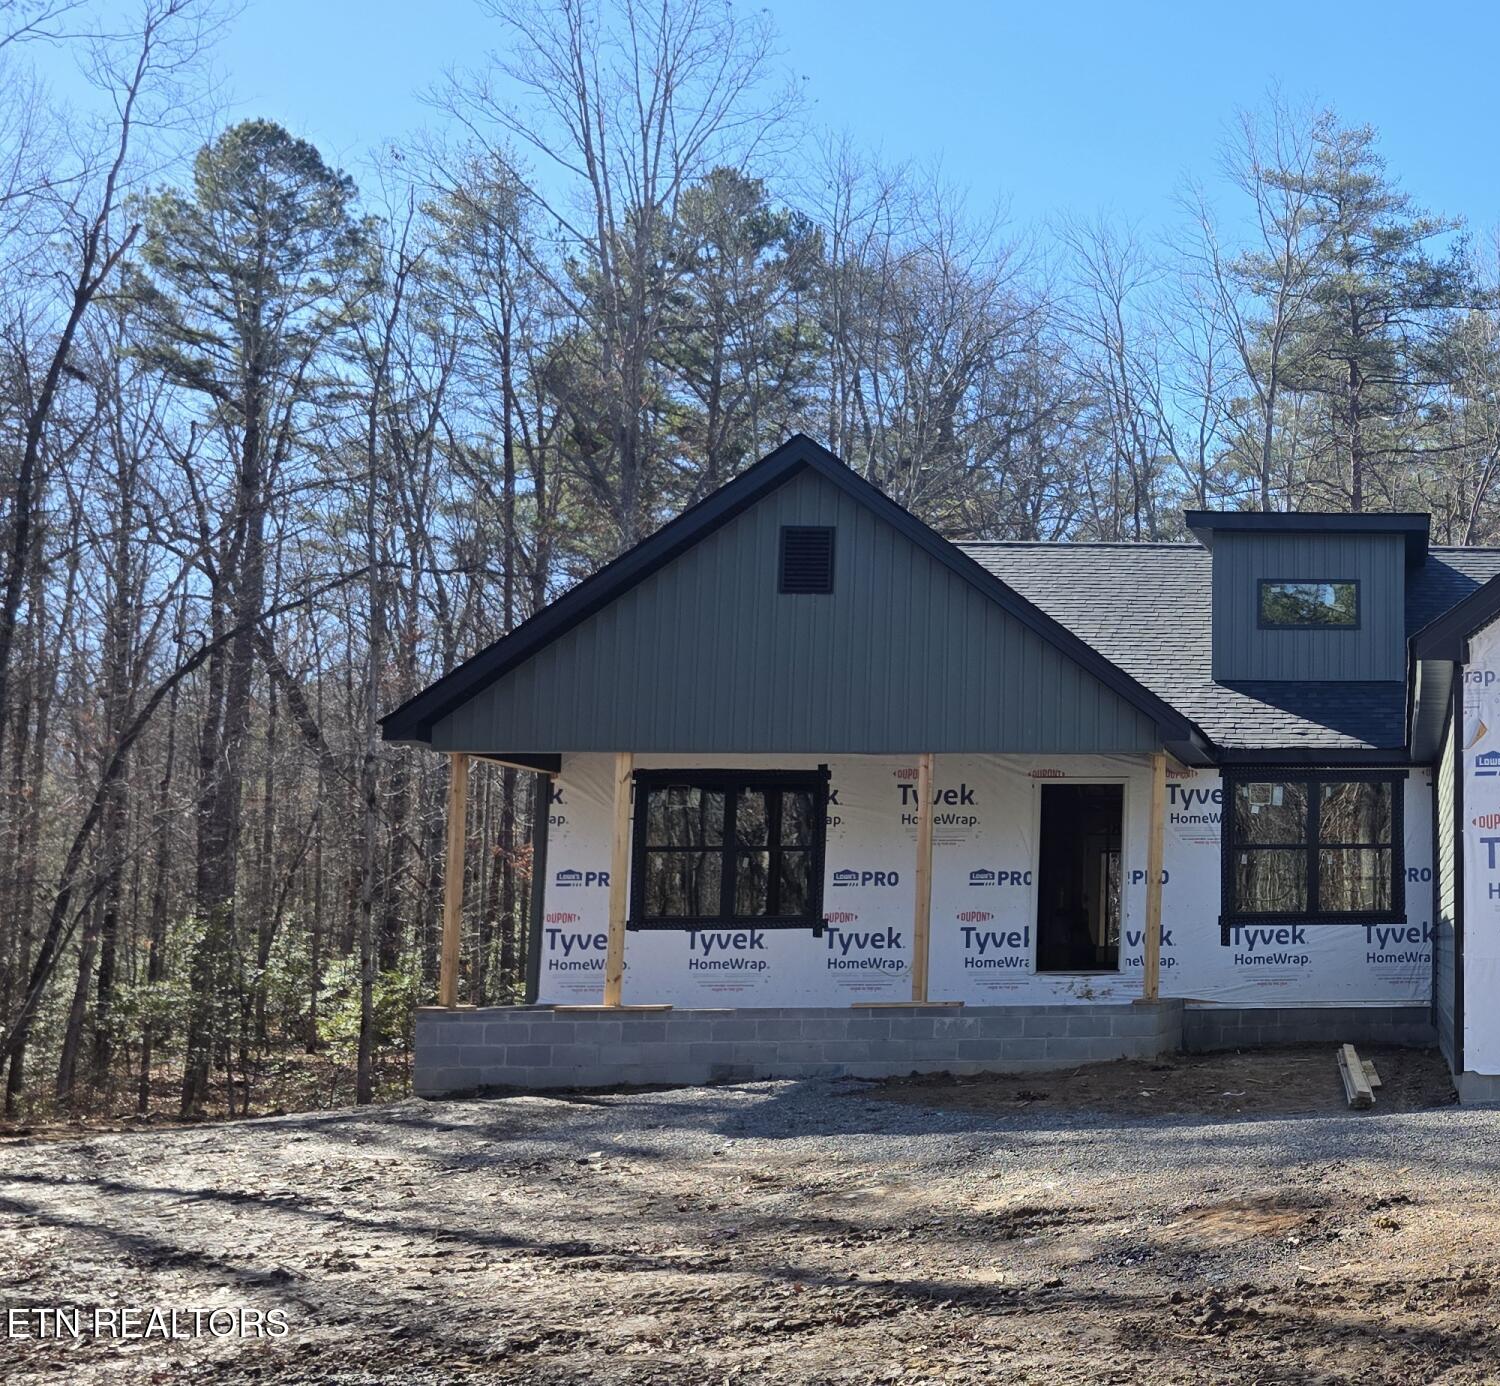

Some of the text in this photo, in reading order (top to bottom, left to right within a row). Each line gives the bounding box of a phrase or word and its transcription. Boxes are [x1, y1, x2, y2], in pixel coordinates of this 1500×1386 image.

[897, 768, 919, 780] DUPO
[1165, 783, 1223, 811] Tyve
[901, 813, 977, 827] HoeWrap
[1170, 812, 1222, 824] HomeW
[585, 871, 610, 887] PR
[861, 871, 899, 887] PRO
[1404, 867, 1432, 882] RO
[960, 911, 991, 922] DUPONT
[545, 928, 608, 957] Tyve
[685, 928, 765, 956] Tyvek
[823, 926, 902, 956] Tyvek
[1231, 925, 1306, 951] Tyvek
[827, 957, 904, 971] HomeWrap
[964, 956, 1030, 968] HomeWra
[1234, 952, 1309, 967] HomeWrap
[1366, 951, 1431, 964] HomeWra
[549, 959, 627, 971] HomeW
[688, 958, 767, 972] HomeWrap
